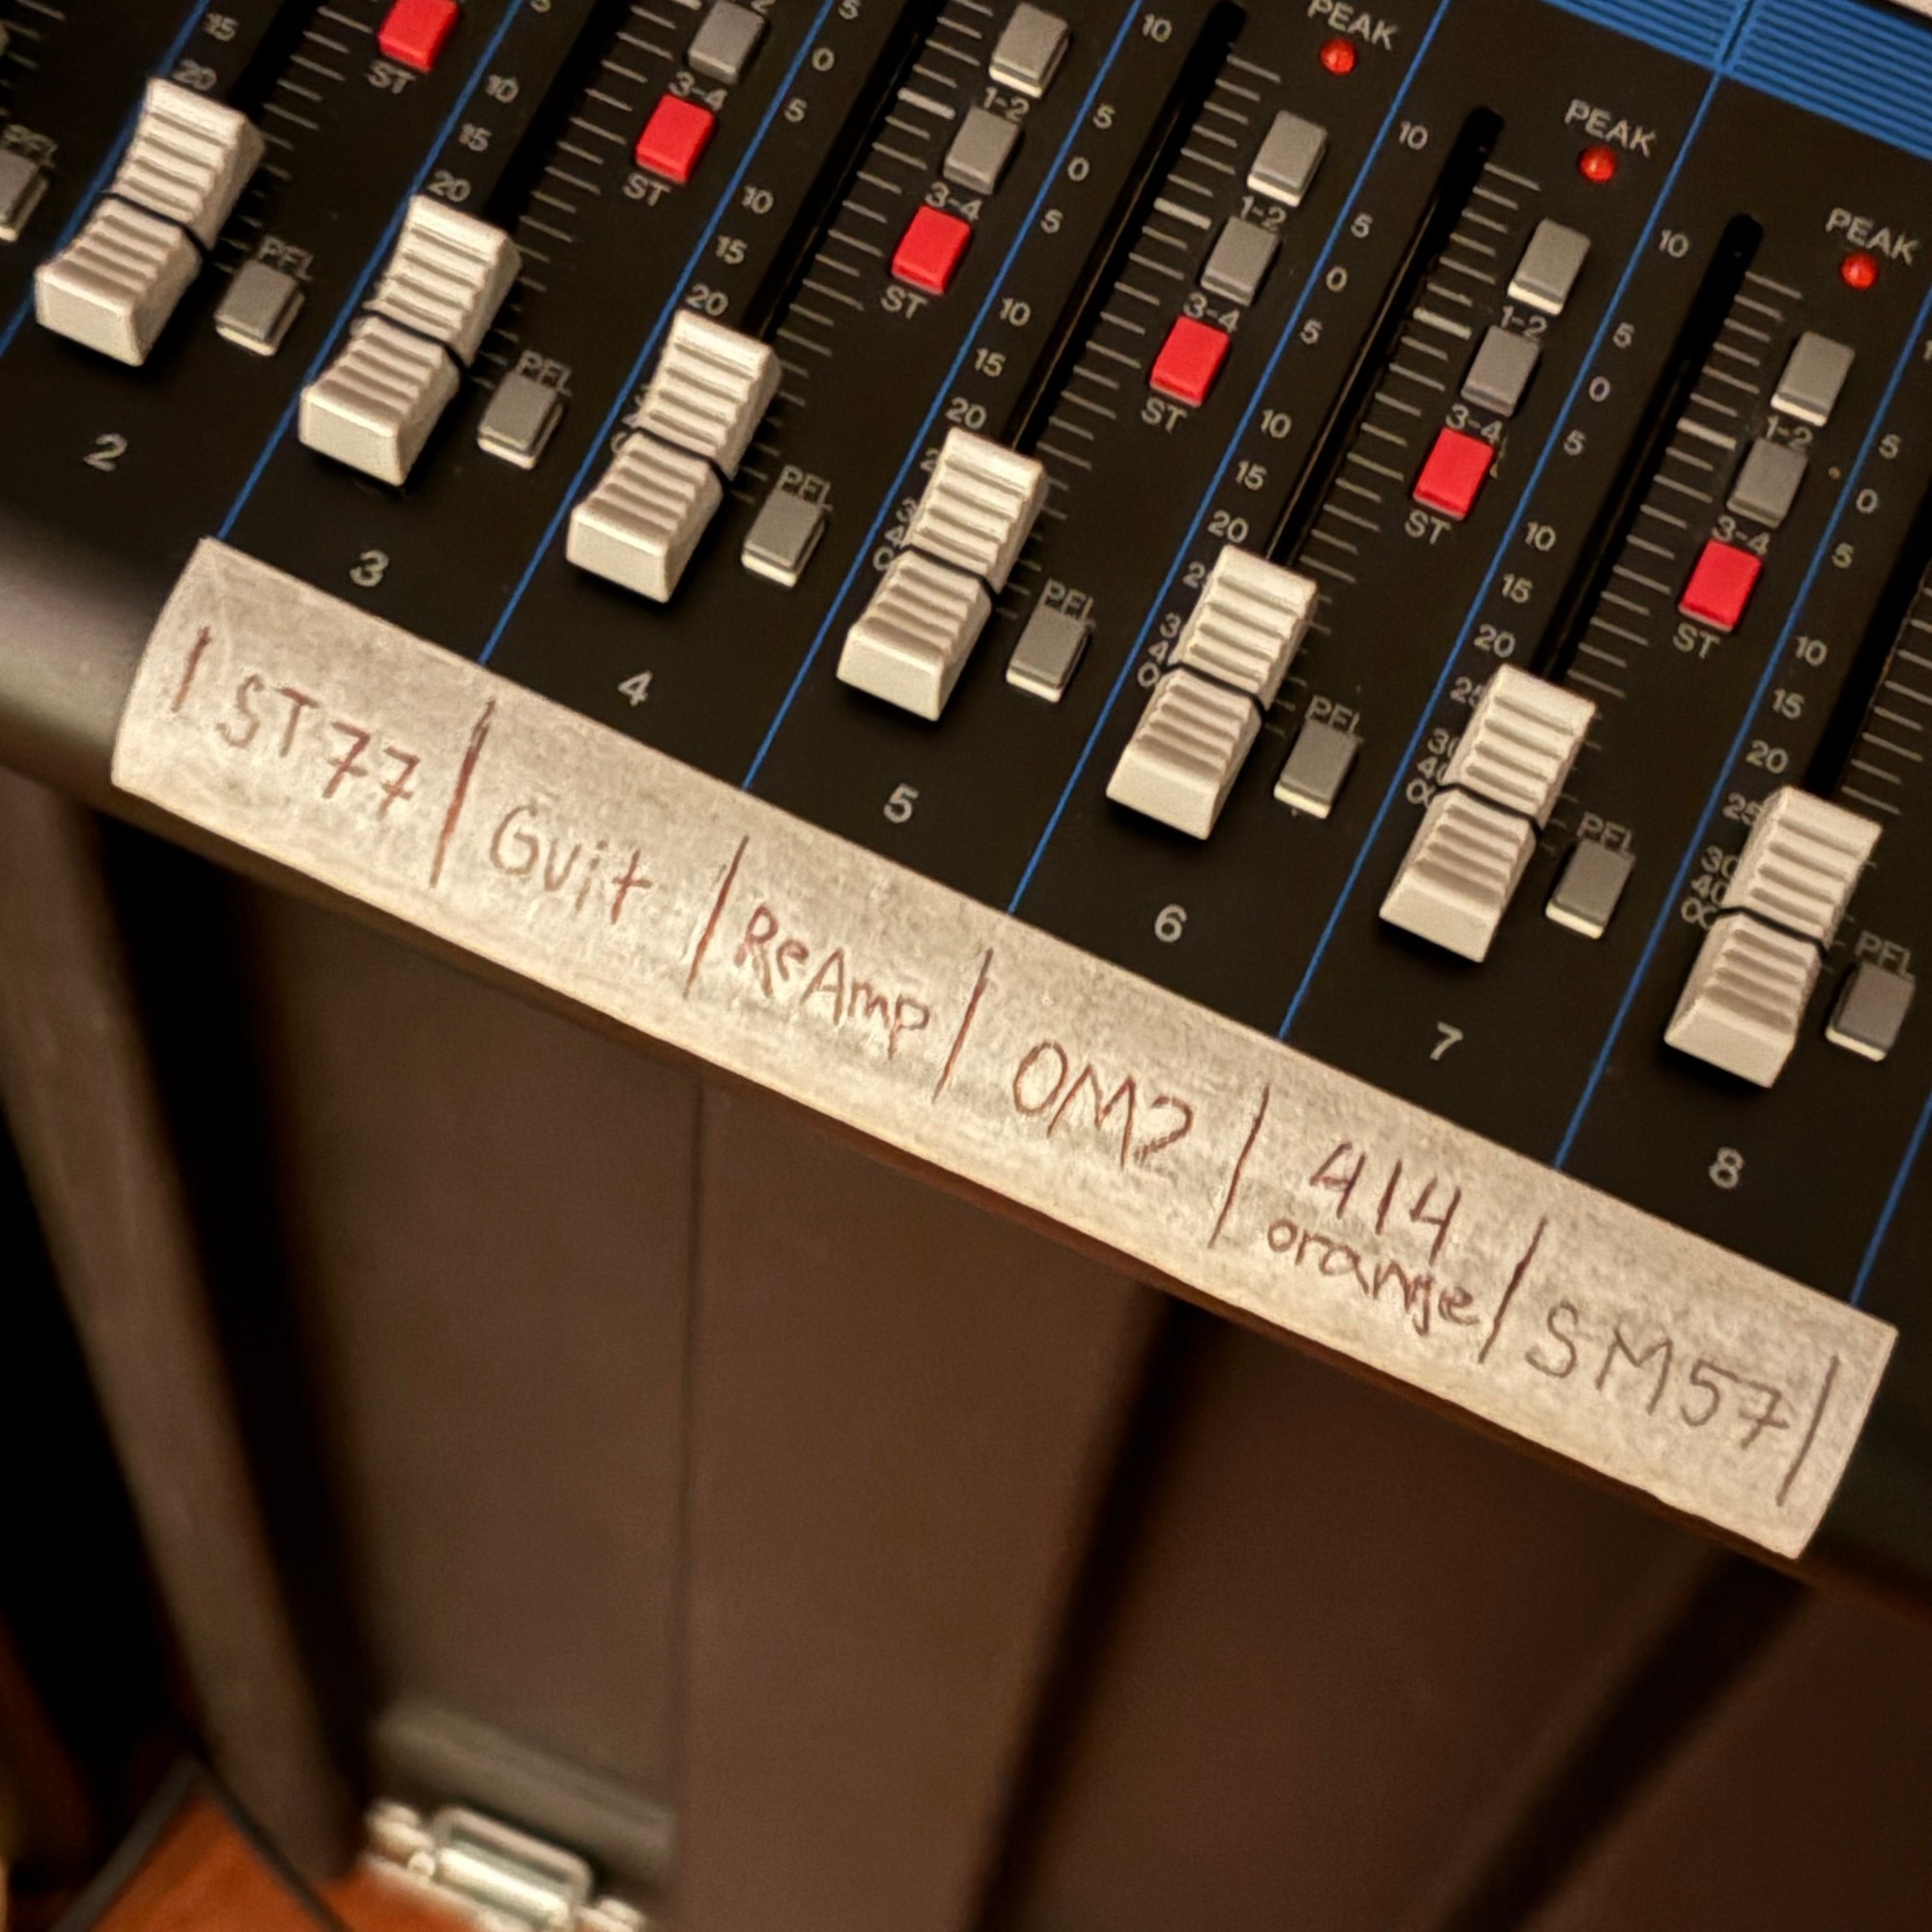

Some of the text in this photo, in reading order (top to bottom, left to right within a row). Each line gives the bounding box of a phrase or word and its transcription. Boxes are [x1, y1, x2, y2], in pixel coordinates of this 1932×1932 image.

[1142, 14, 1172, 43] 10
[1307, 0, 1398, 49] PEAK
[174, 59, 217, 91] 20
[811, 48, 835, 71] 0
[367, 62, 415, 94] ST
[486, 74, 519, 103] 10
[668, 71, 727, 111] 3-4
[784, 99, 808, 123] 5
[983, 87, 1030, 124] 1-2
[1093, 103, 1116, 128] 5
[1400, 121, 1428, 150] 10
[1564, 99, 1656, 157] PEAK
[1066, 156, 1090, 181] 0
[428, 170, 470, 202] 20
[623, 174, 670, 207] ST
[742, 185, 773, 213] 10
[924, 182, 982, 220] 3-4
[1040, 210, 1063, 234] 5
[1240, 195, 1287, 230] 1-2
[1350, 213, 1373, 238] 5
[715, 236, 748, 264] 15
[1660, 230, 1689, 258] 10
[1826, 208, 1919, 265] PEAK
[259, 236, 313, 280] PFL
[1325, 267, 1348, 291] 0
[685, 284, 728, 316] 20
[880, 286, 927, 319] ST
[999, 298, 1031, 327] 10
[1182, 292, 1240, 332] 3-4
[1300, 320, 1322, 345] 5
[1501, 306, 1548, 338] 1-2
[1612, 323, 1634, 348] 5
[975, 348, 1006, 377] 15
[1589, 377, 1610, 402] 0
[946, 397, 986, 430] 20
[1141, 397, 1187, 432] ST
[1261, 409, 1292, 439] 10
[1445, 404, 1503, 444] 3-4
[1563, 431, 1586, 456] 5
[1766, 415, 1813, 449] 1-2
[1878, 434, 1901, 459] 5
[83, 433, 128, 471] 2
[781, 465, 834, 512] PFL
[1236, 460, 1266, 490] 15
[1856, 488, 1878, 514] 0
[1208, 510, 1248, 543] 20
[1405, 510, 1452, 545] ST
[1524, 522, 1556, 552] 10
[1712, 515, 1771, 555] 3-4
[350, 550, 389, 587] 3
[1832, 542, 1854, 568] 5
[1501, 574, 1533, 603] 15
[1473, 624, 1516, 658] 20
[1672, 622, 1720, 659] ST
[1795, 635, 1828, 667] 10
[618, 670, 653, 706] 4
[1772, 689, 1805, 720] 15
[216, 674, 420, 822] ST77
[1746, 739, 1788, 774] 20
[884, 782, 919, 823] 5
[1154, 904, 1187, 942] 6
[734, 903, 929, 1061] ReAmp
[1430, 1021, 1463, 1061] 7
[1012, 1039, 1194, 1171] OM2
[1708, 1147, 1745, 1189] 8
[1309, 1142, 1462, 1266] 414
[1266, 1218, 1480, 1339] orange
[1524, 1299, 1792, 1450] SM57
